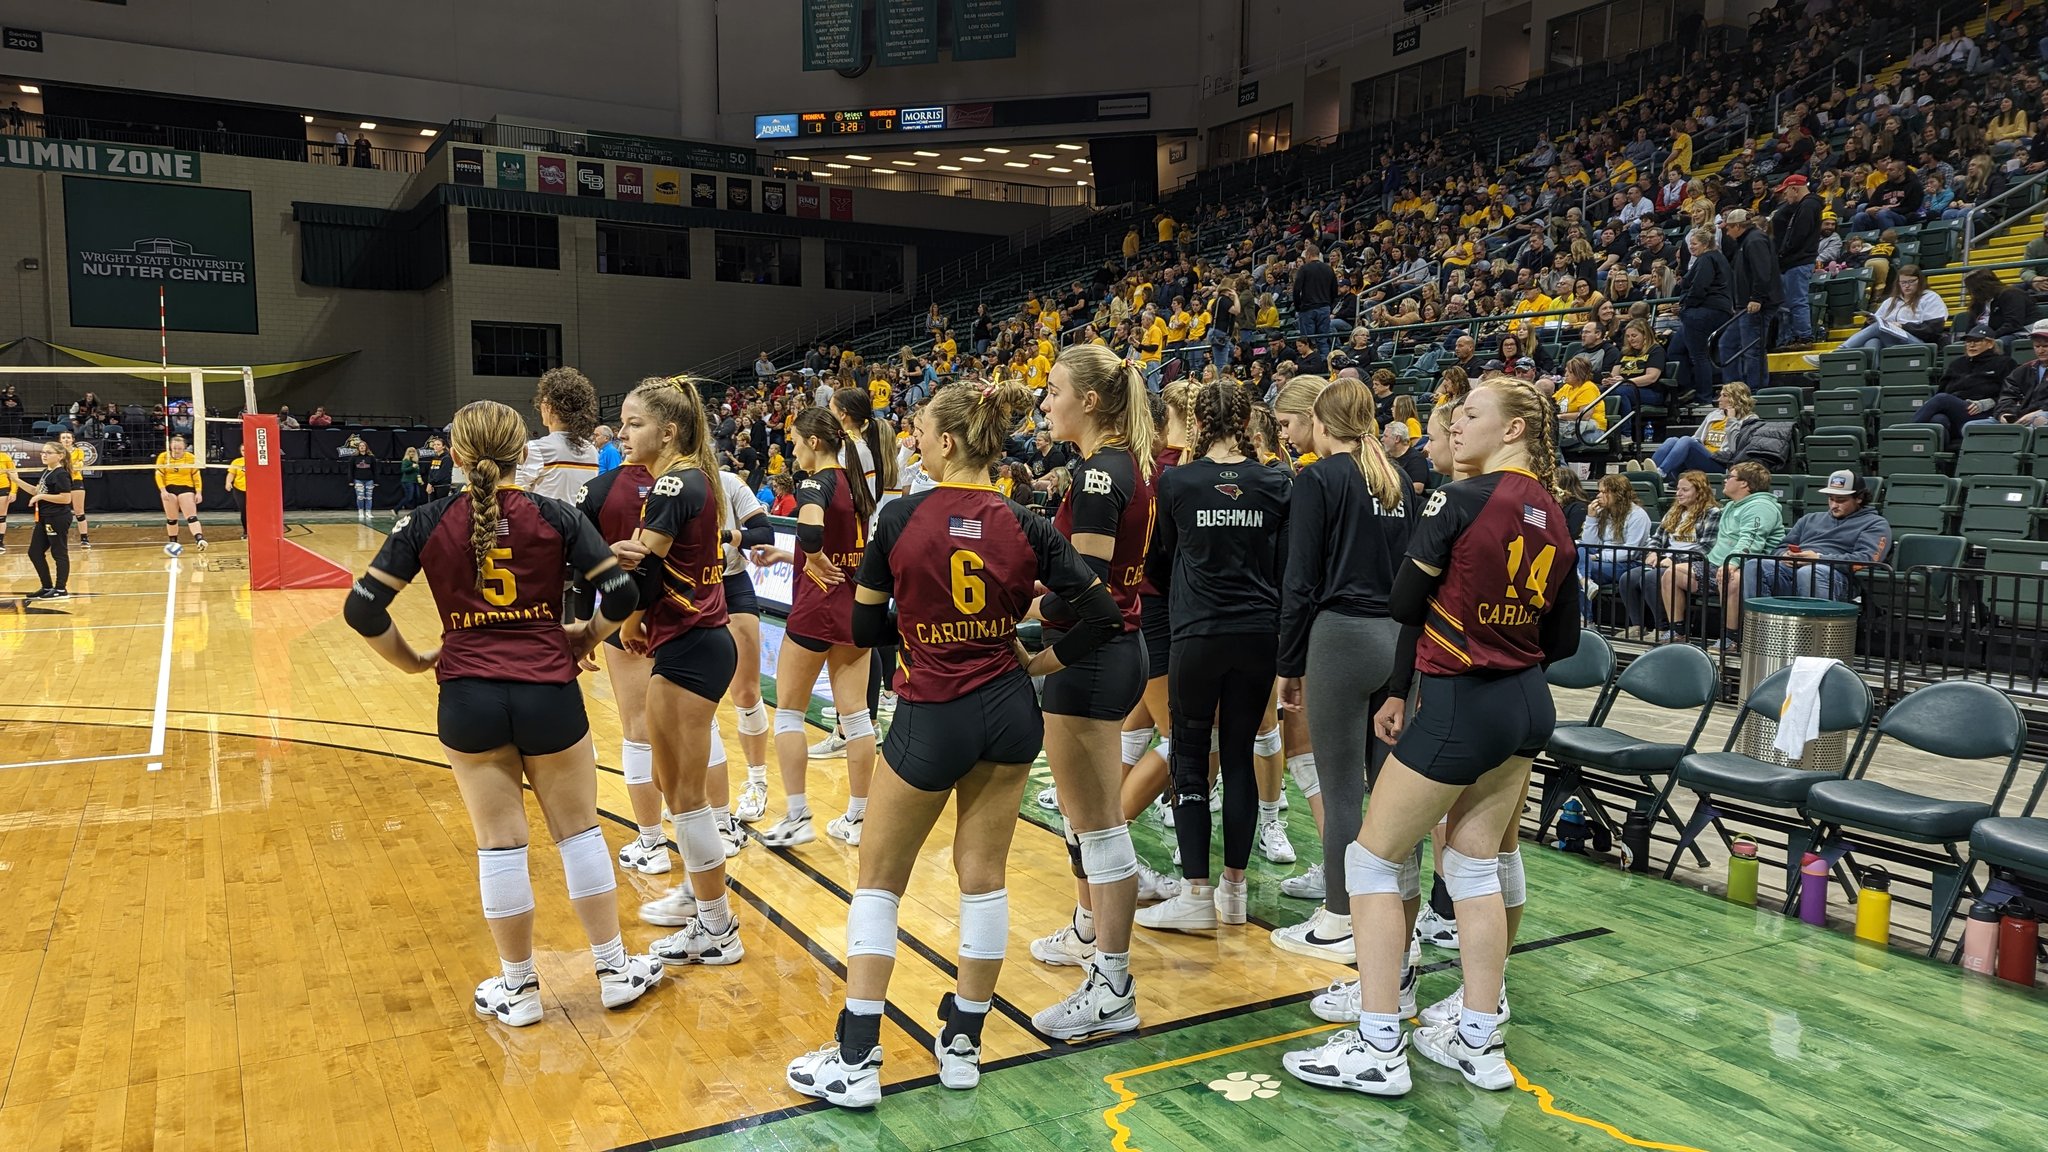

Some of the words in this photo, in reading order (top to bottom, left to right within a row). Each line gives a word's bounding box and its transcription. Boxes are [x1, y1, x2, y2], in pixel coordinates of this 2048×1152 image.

[8, 38, 38, 48] 200
[1396, 38, 1416, 52] 203
[1240, 92, 1256, 102] 202
[905, 111, 941, 121] MORRIS
[762, 124, 792, 134] AQUAFINA
[815, 122, 822, 132] 0
[840, 122, 858, 132] 3:28
[886, 119, 892, 128] 0
[106, 148, 193, 179] ZONE
[729, 153, 746, 165] 50
[618, 184, 642, 195] IUPUI
[798, 196, 818, 206] RMU
[80, 251, 132, 264] WRIGHT
[135, 254, 170, 266] STATE
[173, 256, 246, 271] UNIVERSITY
[83, 262, 164, 279] NUTTER
[169, 267, 246, 284] CENTER
[878, 388, 886, 396] 14
[258, 429, 266, 460] PORTER
[1196, 510, 1263, 527] BUSHMAN
[481, 548, 518, 606] 5
[1505, 535, 1557, 610] 14
[950, 550, 986, 615] 6
